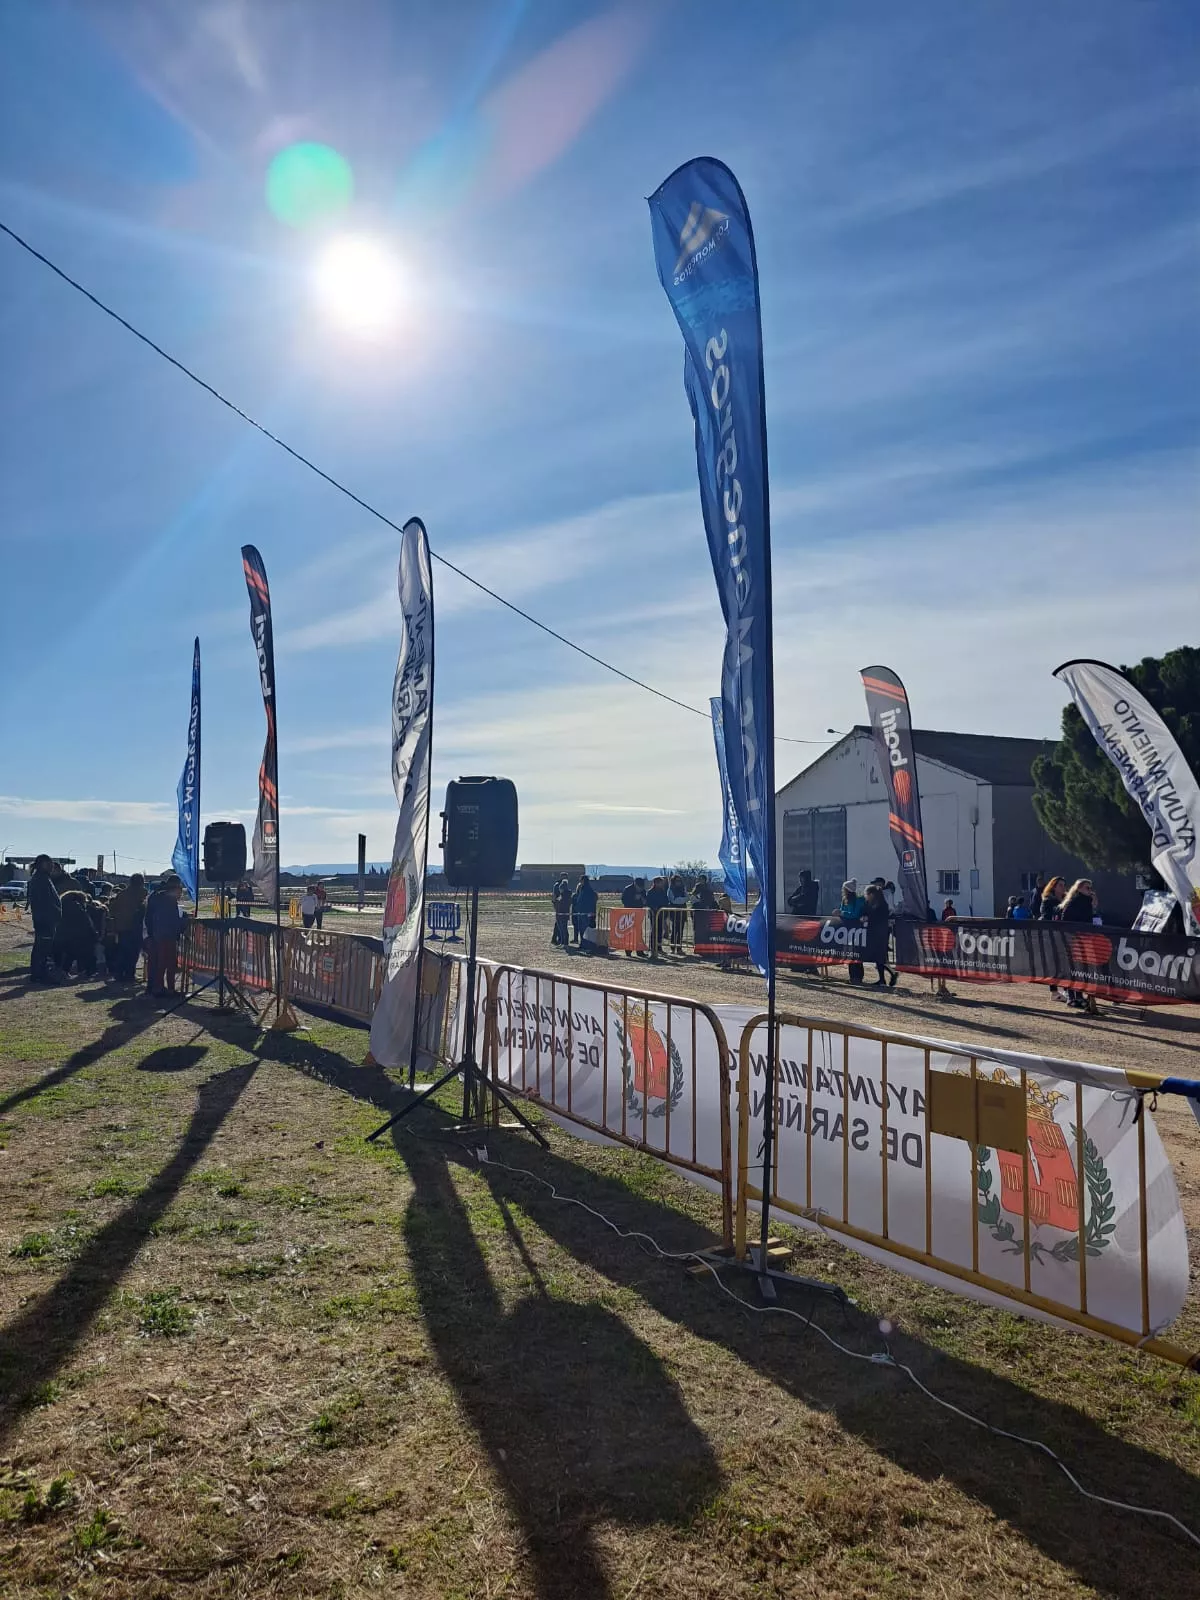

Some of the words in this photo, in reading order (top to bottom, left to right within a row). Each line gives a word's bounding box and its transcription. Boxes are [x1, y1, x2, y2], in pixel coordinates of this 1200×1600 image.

[821, 919, 868, 947] barri
[957, 927, 1015, 957] barri
[1116, 937, 1196, 982] barri
[1070, 968, 1177, 995] www.barrisportline.com
